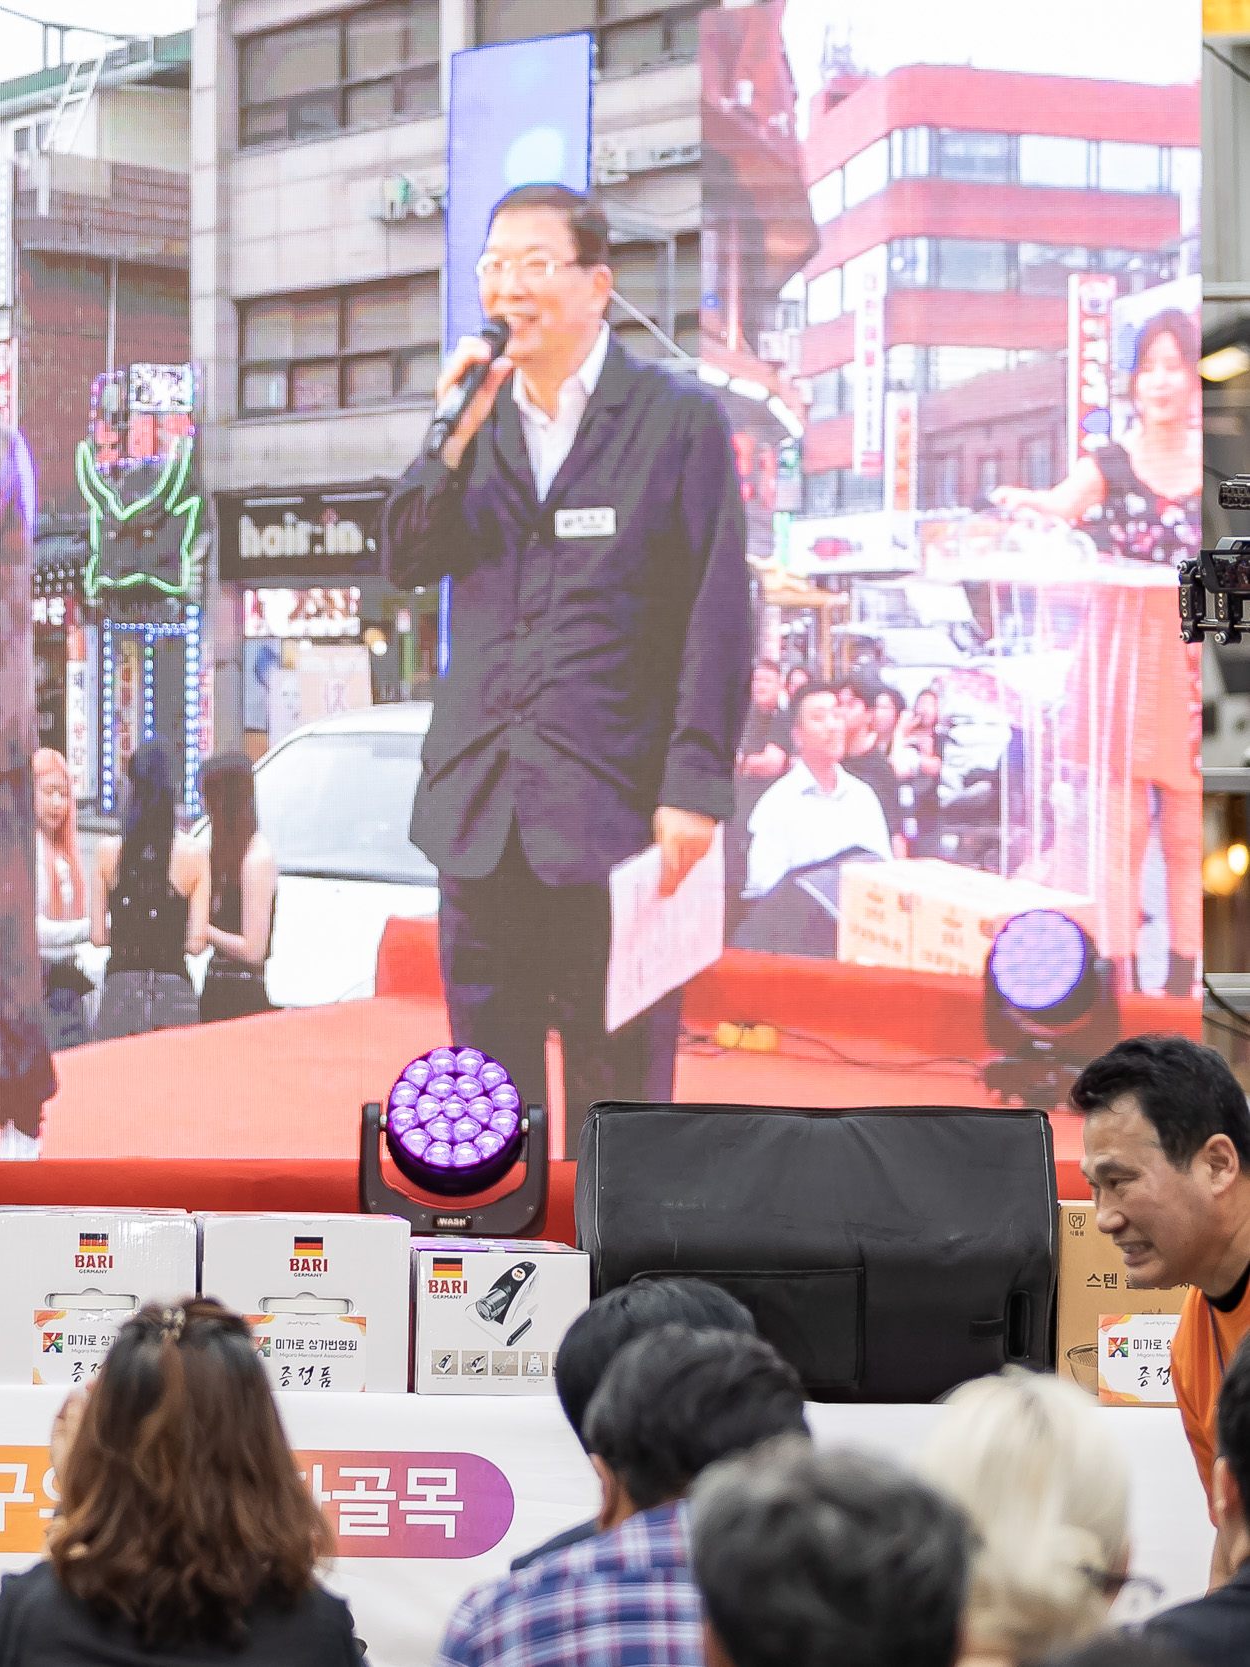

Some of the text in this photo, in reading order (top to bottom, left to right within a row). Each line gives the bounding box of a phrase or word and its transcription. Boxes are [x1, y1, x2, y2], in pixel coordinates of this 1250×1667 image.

[437, 1217, 467, 1226] WASH
[74, 1255, 114, 1269] BARI
[289, 1258, 328, 1272] BARI
[428, 1280, 468, 1294] BARI
[1086, 1273, 1118, 1289] 스텐
[67, 1334, 97, 1346] 미가로
[275, 1338, 358, 1351] 미가로 상가번영회
[1133, 1338, 1163, 1350] 미가로
[1137, 1366, 1172, 1388] 증정
[300, 1463, 464, 1538] 골목
